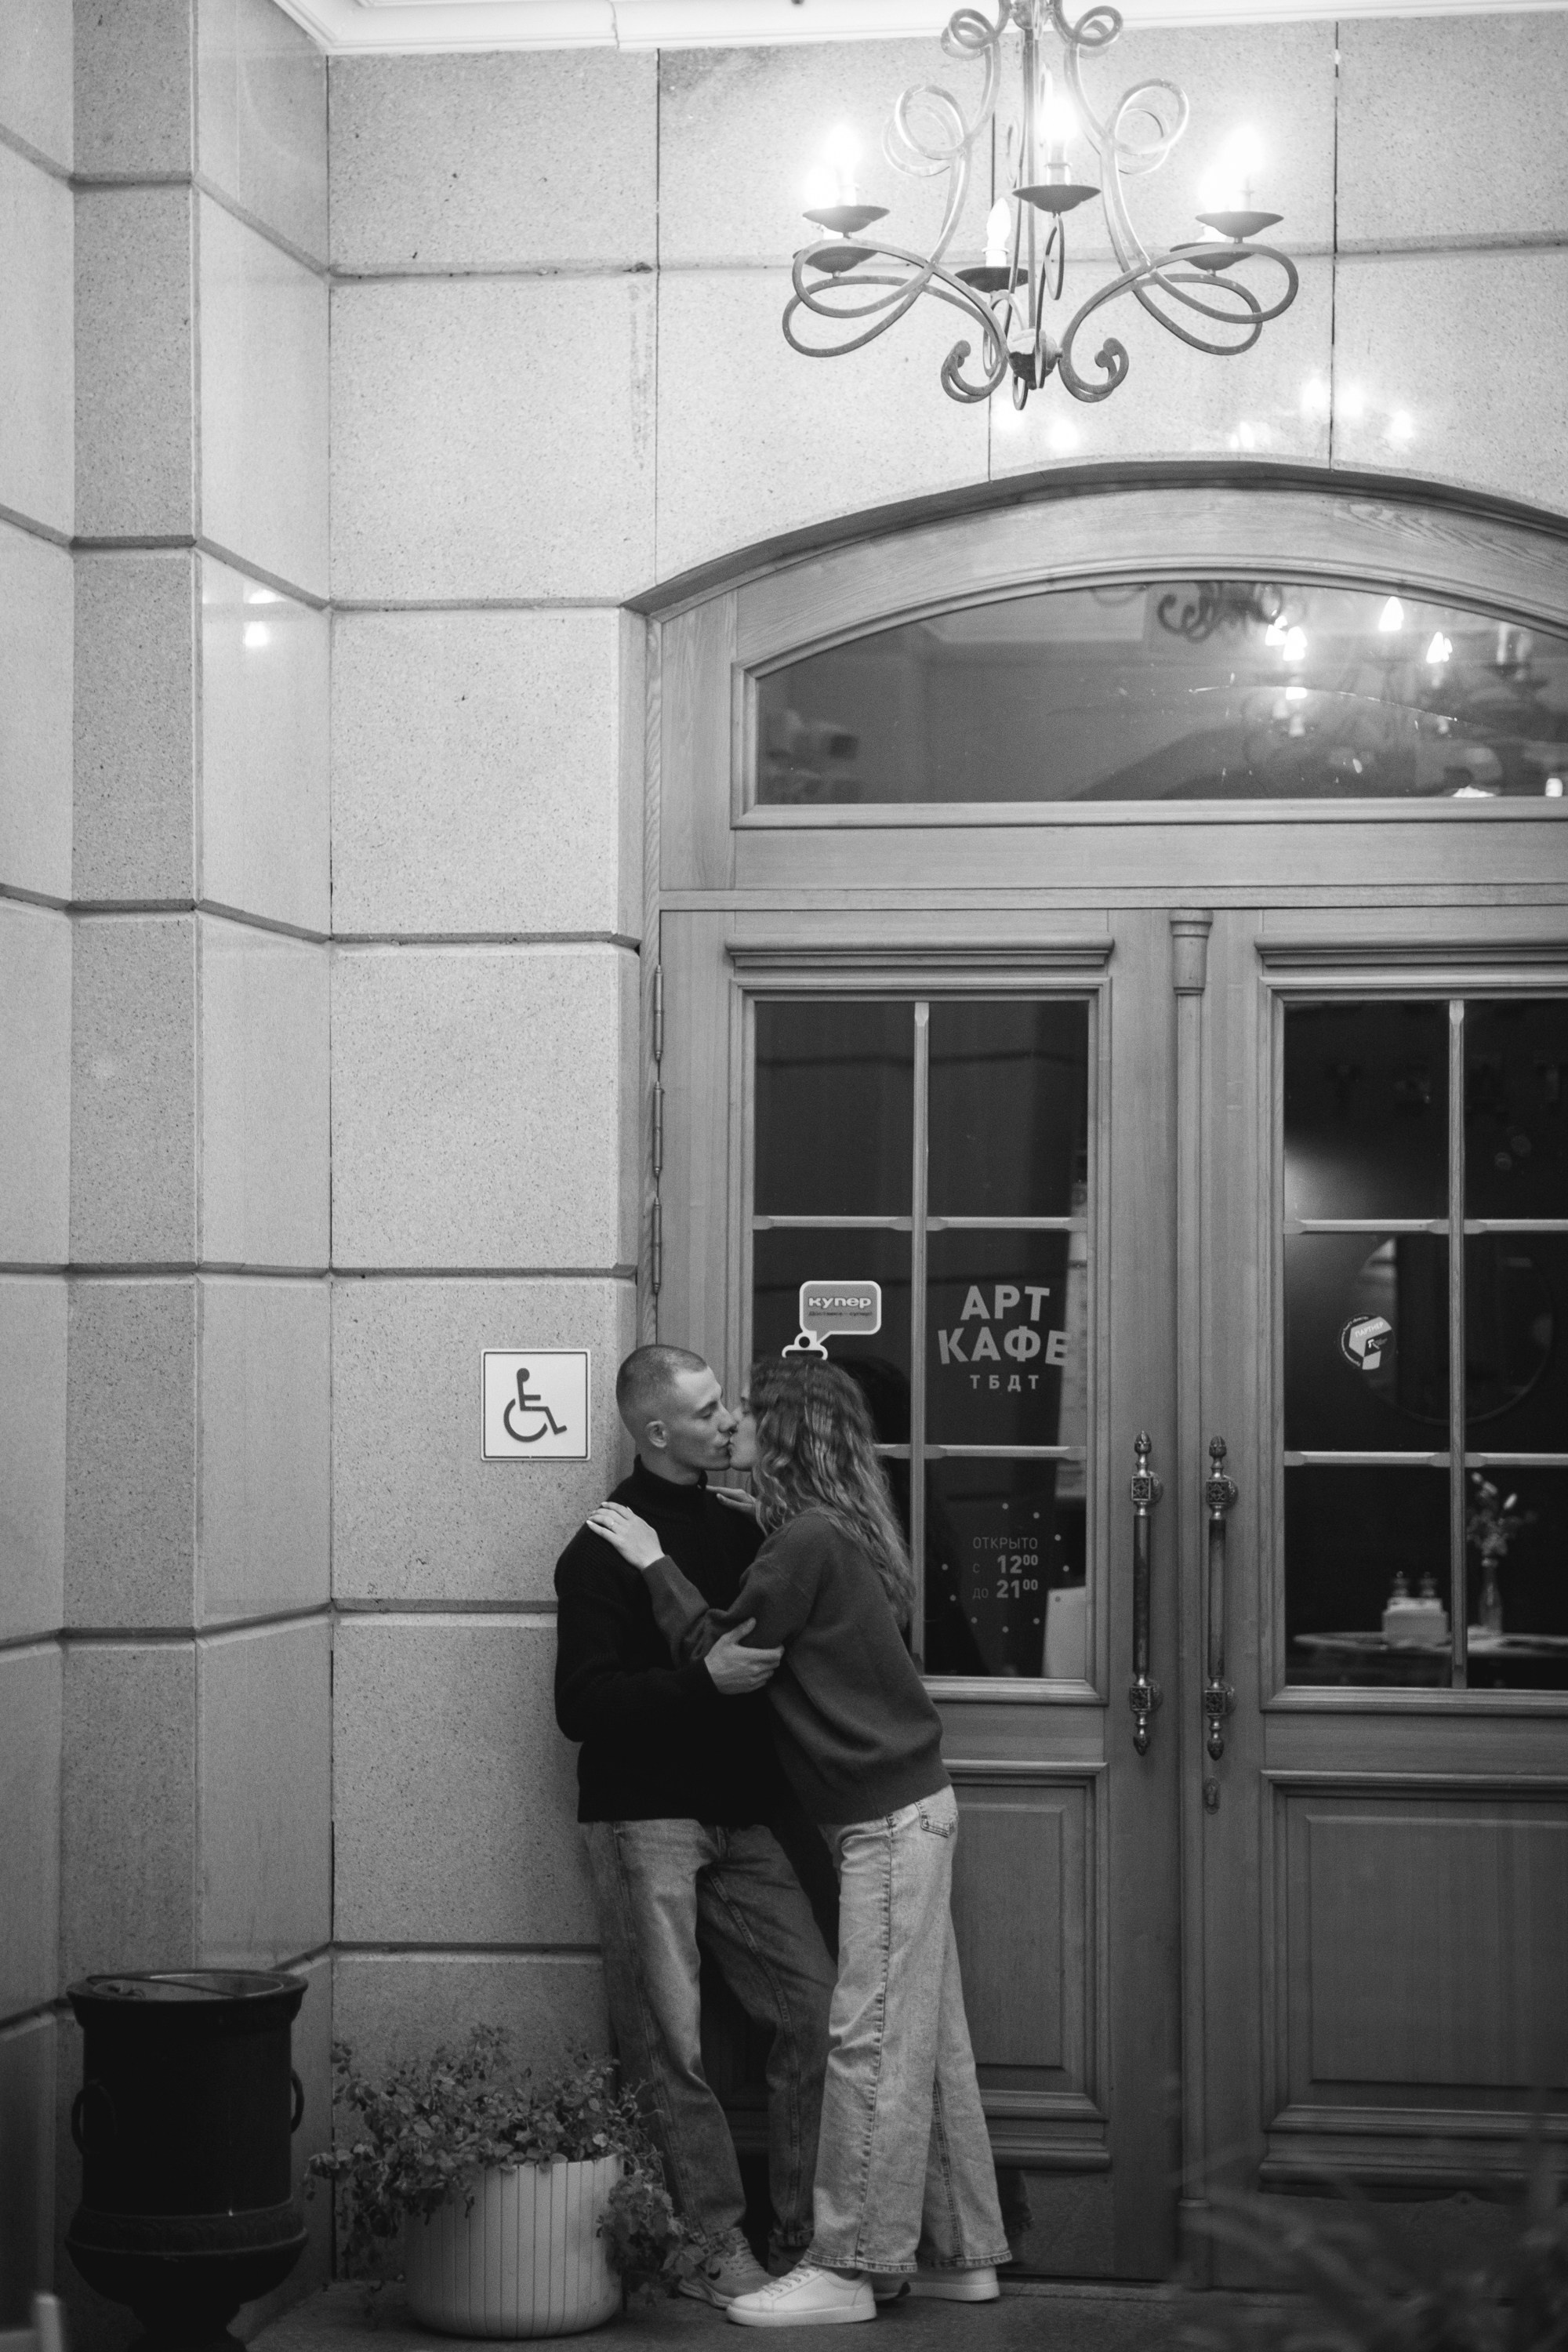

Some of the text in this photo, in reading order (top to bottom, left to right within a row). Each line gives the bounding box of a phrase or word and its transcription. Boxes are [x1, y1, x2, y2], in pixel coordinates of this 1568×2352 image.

[808, 1297, 872, 1309] купер
[960, 1284, 1051, 1321] АРТ
[938, 1325, 1071, 1367] КАФЕ
[973, 1537, 1038, 1549] ОТКРЫТО
